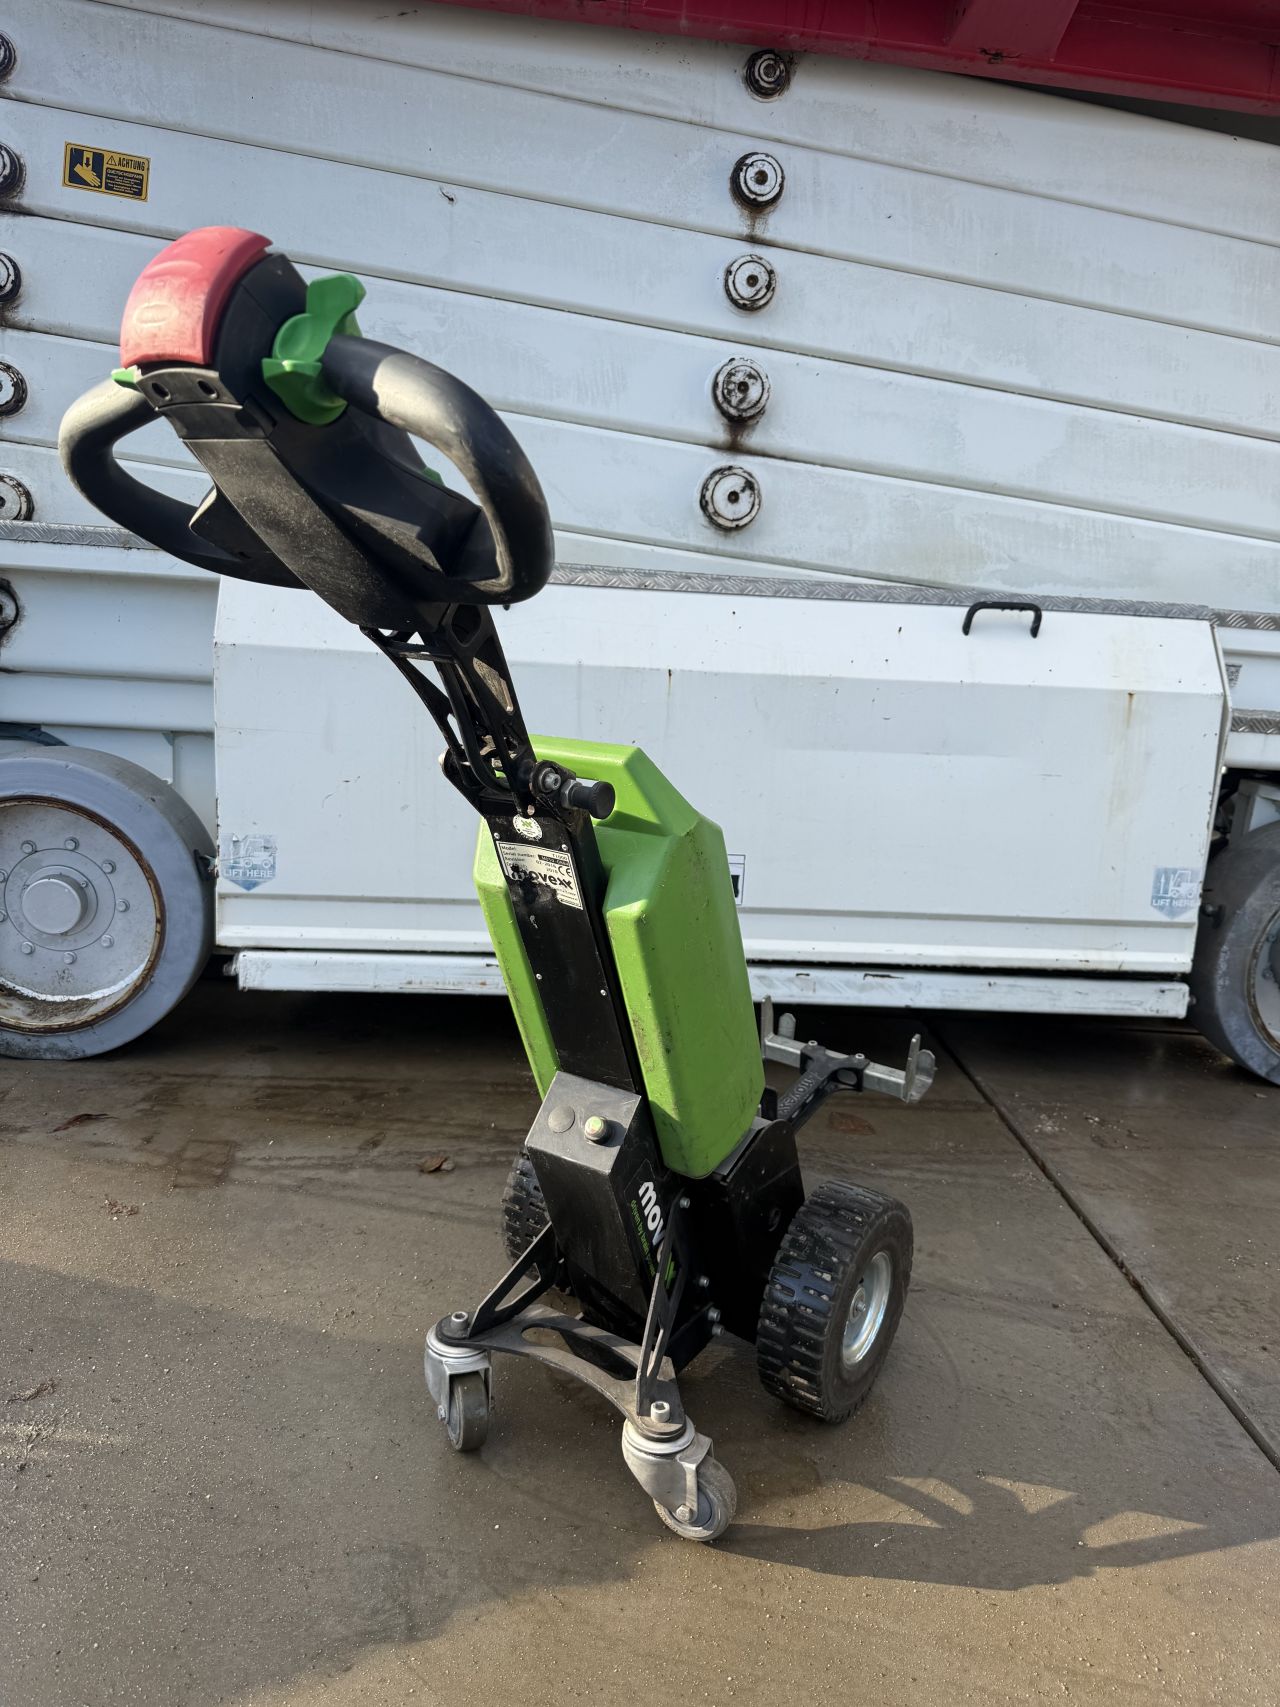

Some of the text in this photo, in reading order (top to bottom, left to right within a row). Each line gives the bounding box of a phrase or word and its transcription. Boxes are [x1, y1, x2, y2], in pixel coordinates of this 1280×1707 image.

[117, 157, 146, 172] ACHTUNG
[222, 869, 273, 878] LIFT HERE
